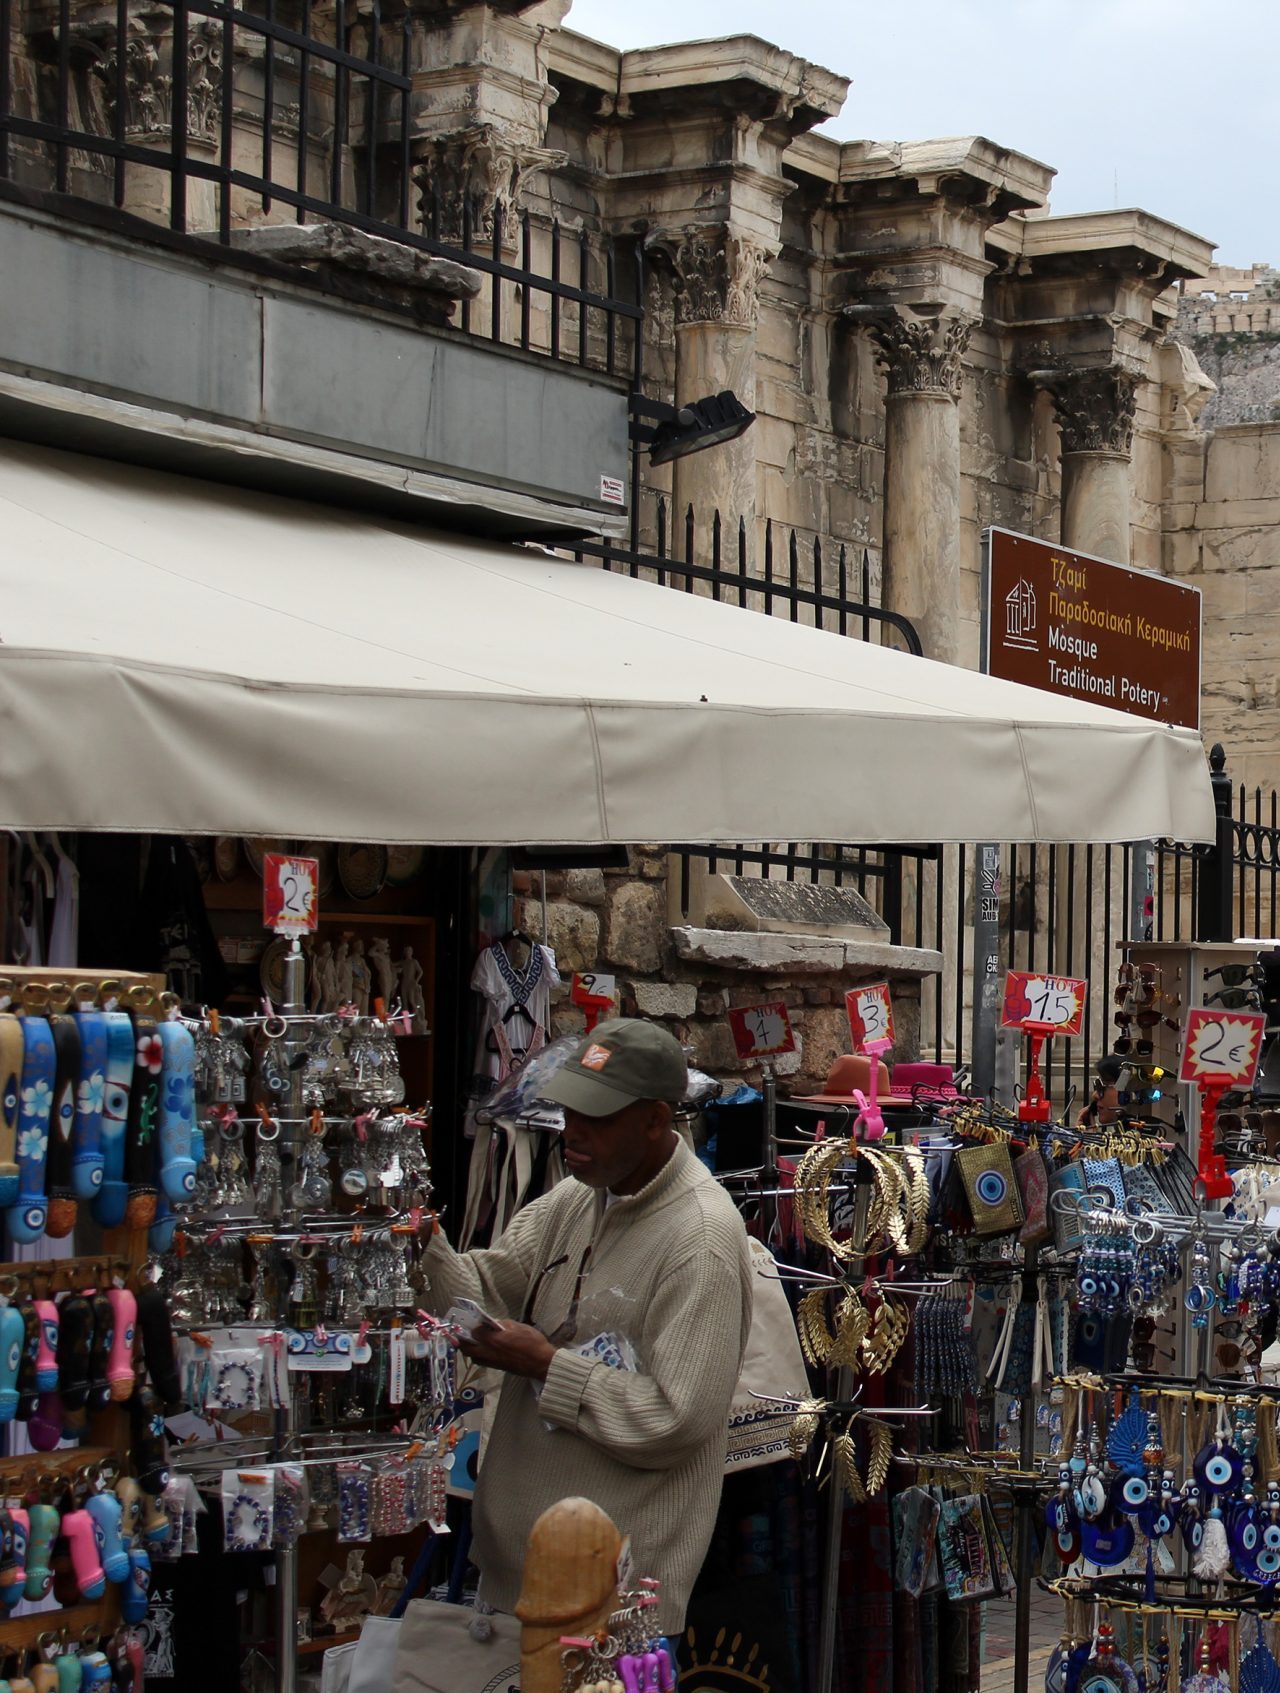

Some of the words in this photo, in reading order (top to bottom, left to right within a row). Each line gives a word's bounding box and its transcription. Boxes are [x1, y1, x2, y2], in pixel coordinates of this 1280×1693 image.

[1050, 557, 1087, 592] Τζαμί
[1049, 591, 1132, 636] Παραδοσιακή
[1136, 616, 1191, 652] Κεραμική
[1048, 624, 1098, 662] Mosque
[1048, 659, 1116, 698] Traditional
[1121, 677, 1161, 713] Potery
[1045, 979, 1077, 992] HOT
